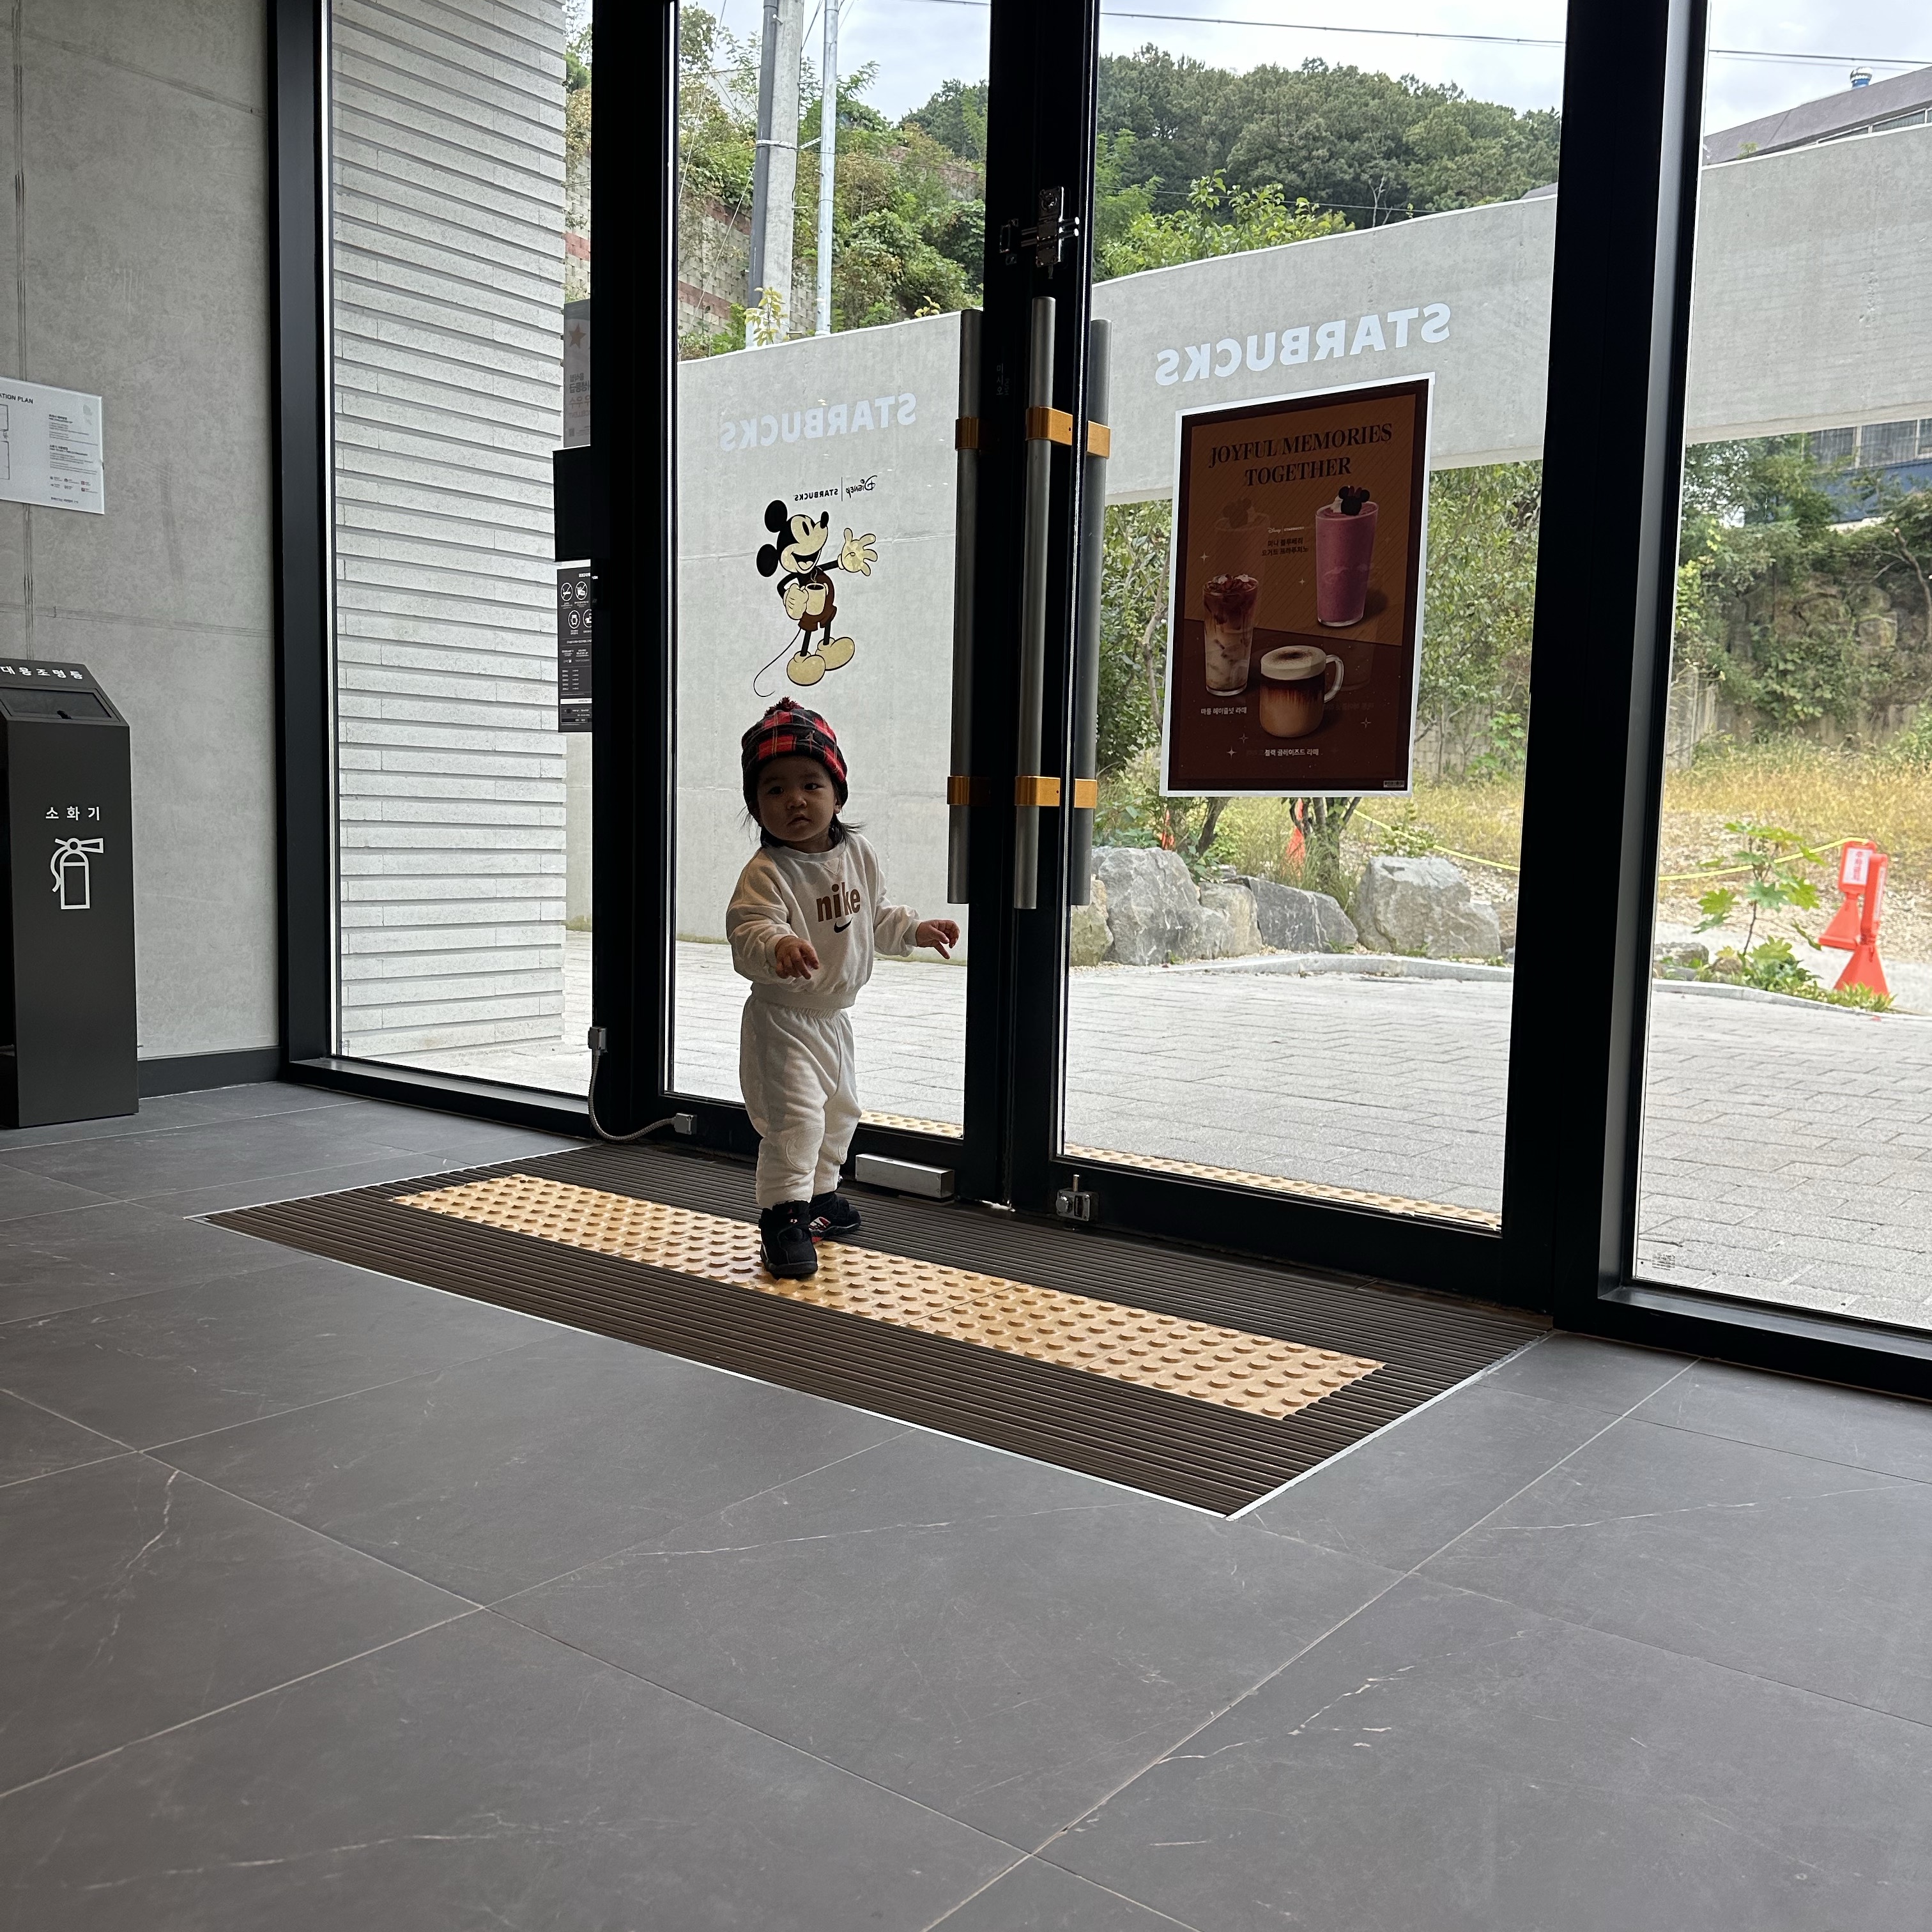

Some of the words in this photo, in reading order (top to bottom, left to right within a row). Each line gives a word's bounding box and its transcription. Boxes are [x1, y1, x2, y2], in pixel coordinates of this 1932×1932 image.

[1208, 440, 1277, 468] JOYFUL
[1282, 423, 1392, 455] MEMORIES
[1245, 457, 1351, 486] TOGETHER
[1280, 546, 1309, 555] 프라푸치노
[45, 806, 100, 821] 소화기
[816, 882, 861, 923] nike
